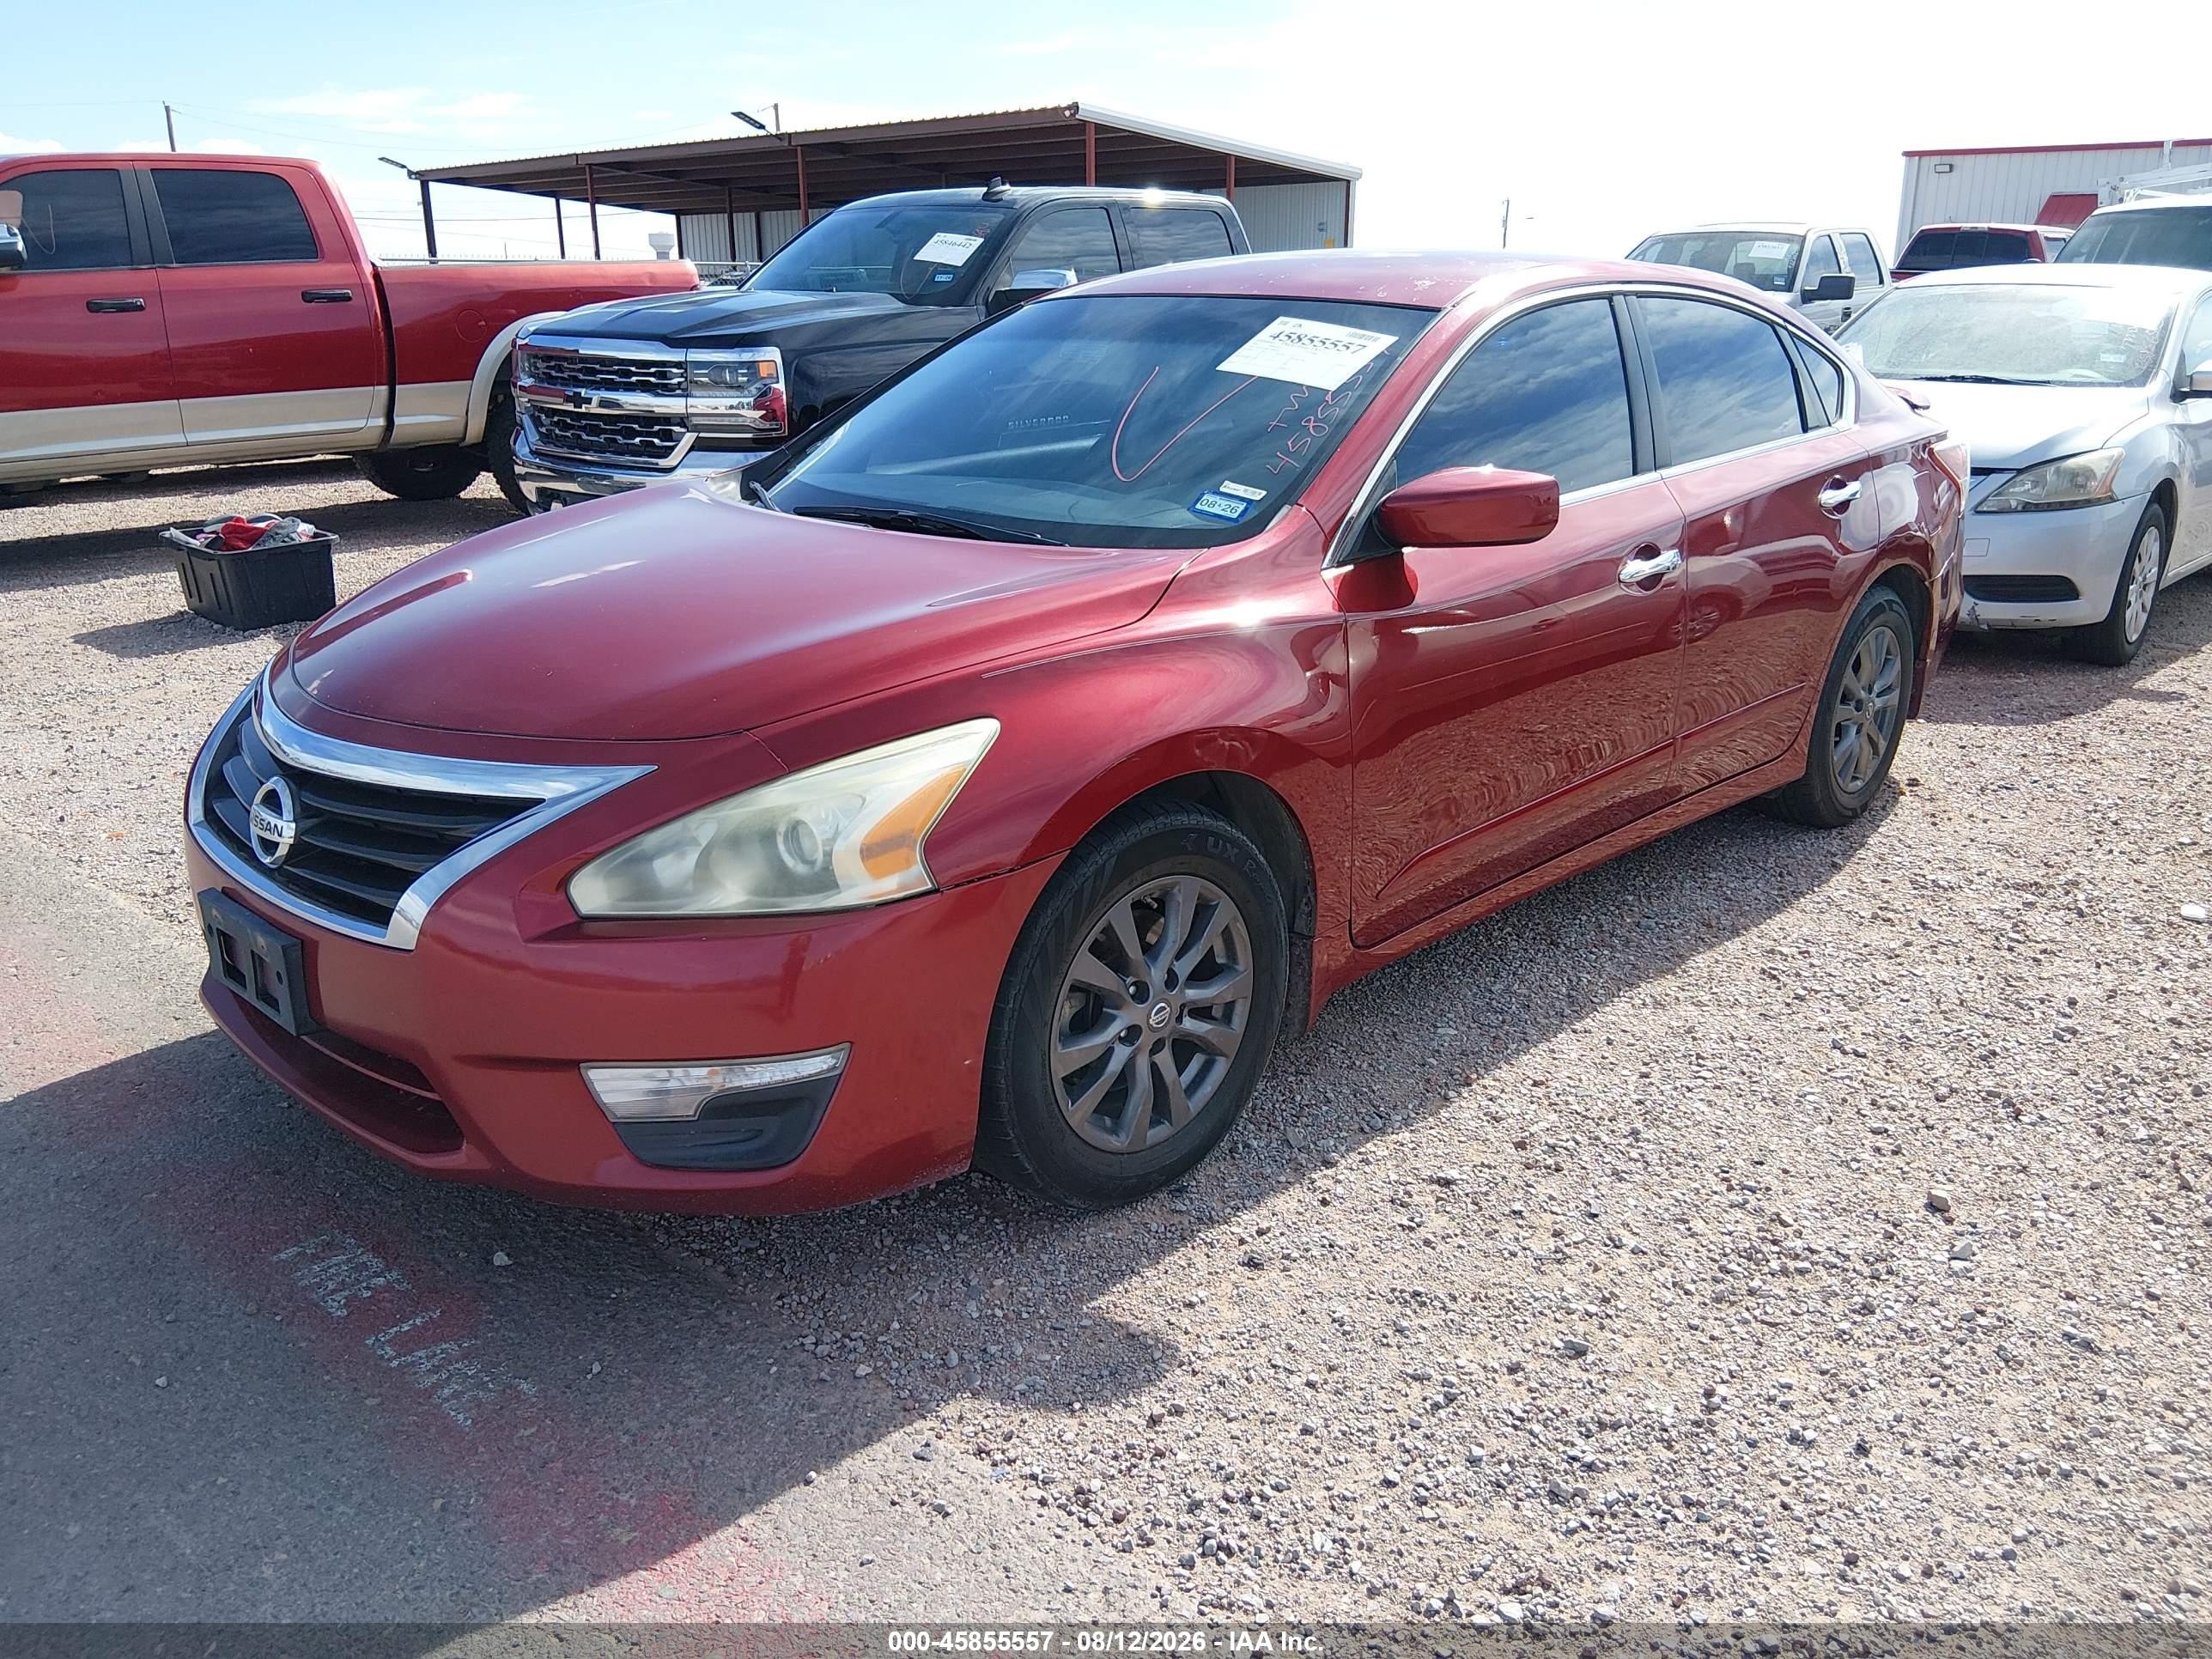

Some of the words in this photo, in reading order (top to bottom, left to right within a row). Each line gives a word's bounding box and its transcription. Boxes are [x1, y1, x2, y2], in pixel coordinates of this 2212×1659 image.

[1268, 330, 1368, 354] 45855557
[1200, 498, 1218, 509] 08
[1221, 503, 1240, 514] 26
